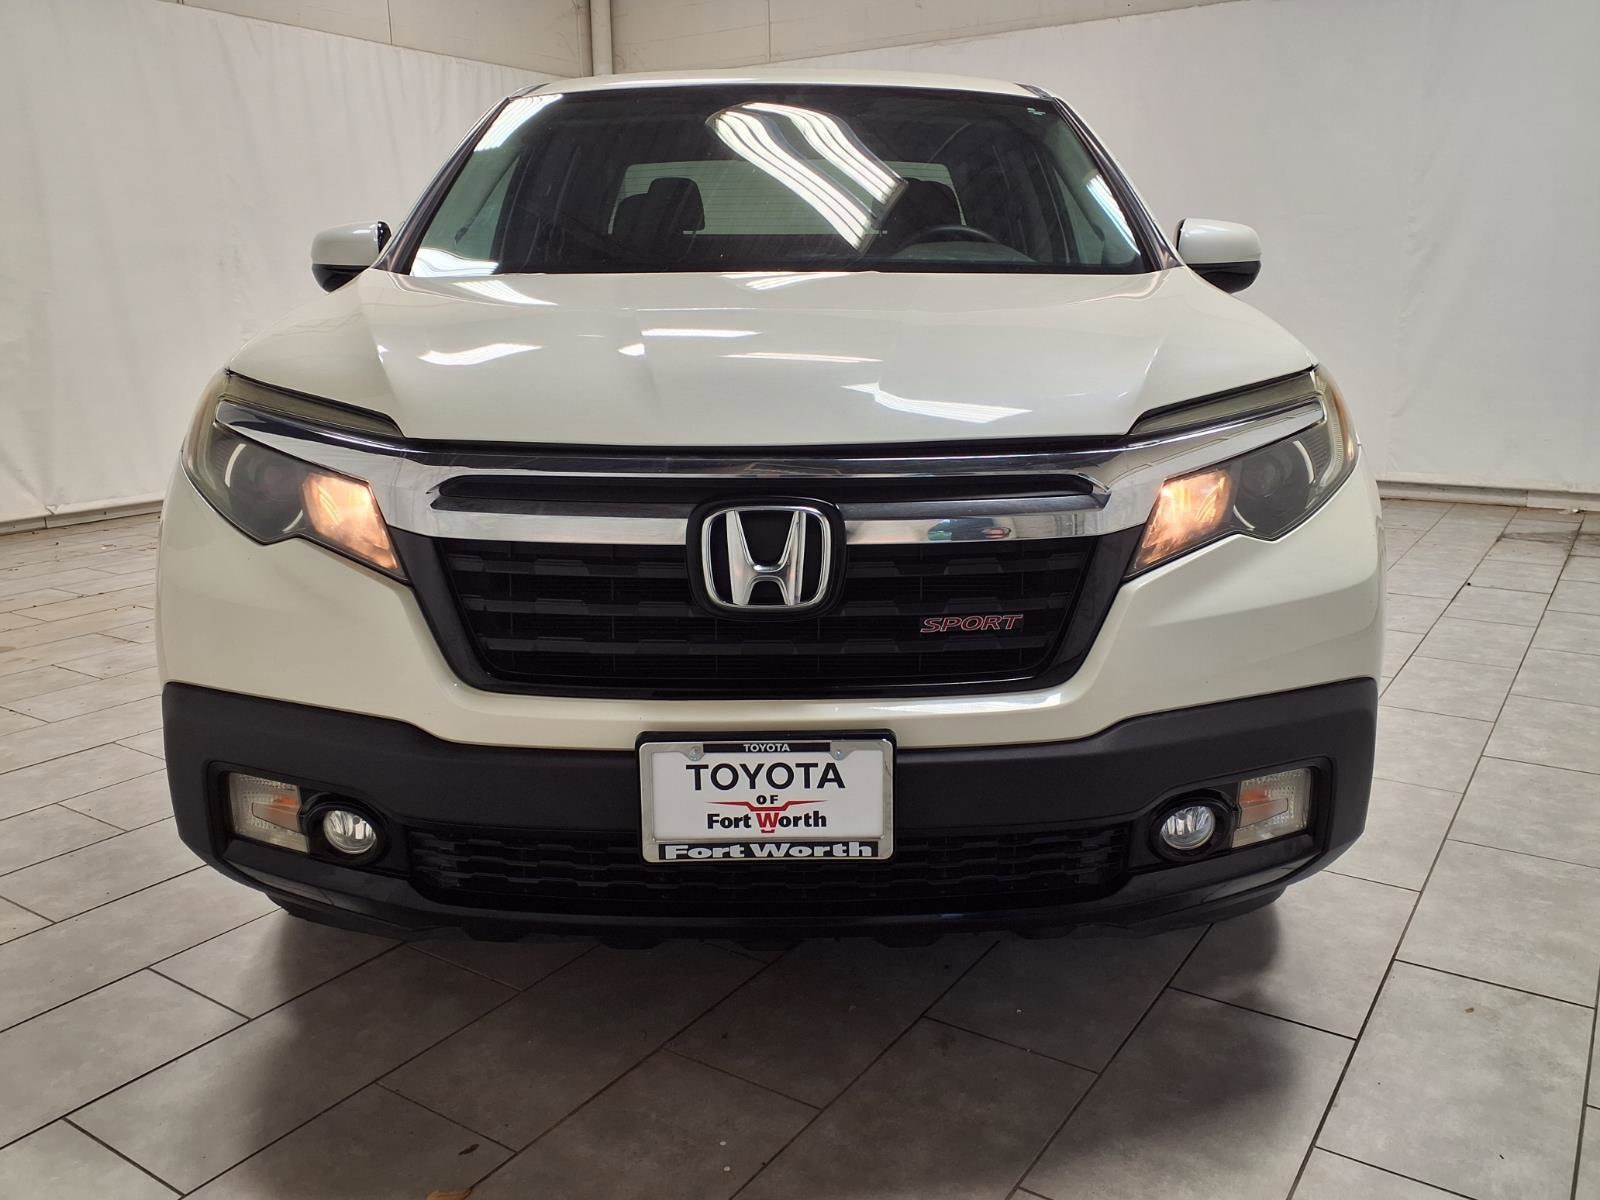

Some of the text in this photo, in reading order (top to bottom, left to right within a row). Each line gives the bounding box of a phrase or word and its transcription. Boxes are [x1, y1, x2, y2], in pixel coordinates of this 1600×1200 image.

[920, 614, 1023, 633] SPORT
[743, 743, 790, 752] TOYOTA
[685, 762, 846, 791] TOYOTA
[756, 795, 779, 805] OF
[707, 811, 827, 829] Fort Worth
[665, 842, 872, 859] Fort Worth
